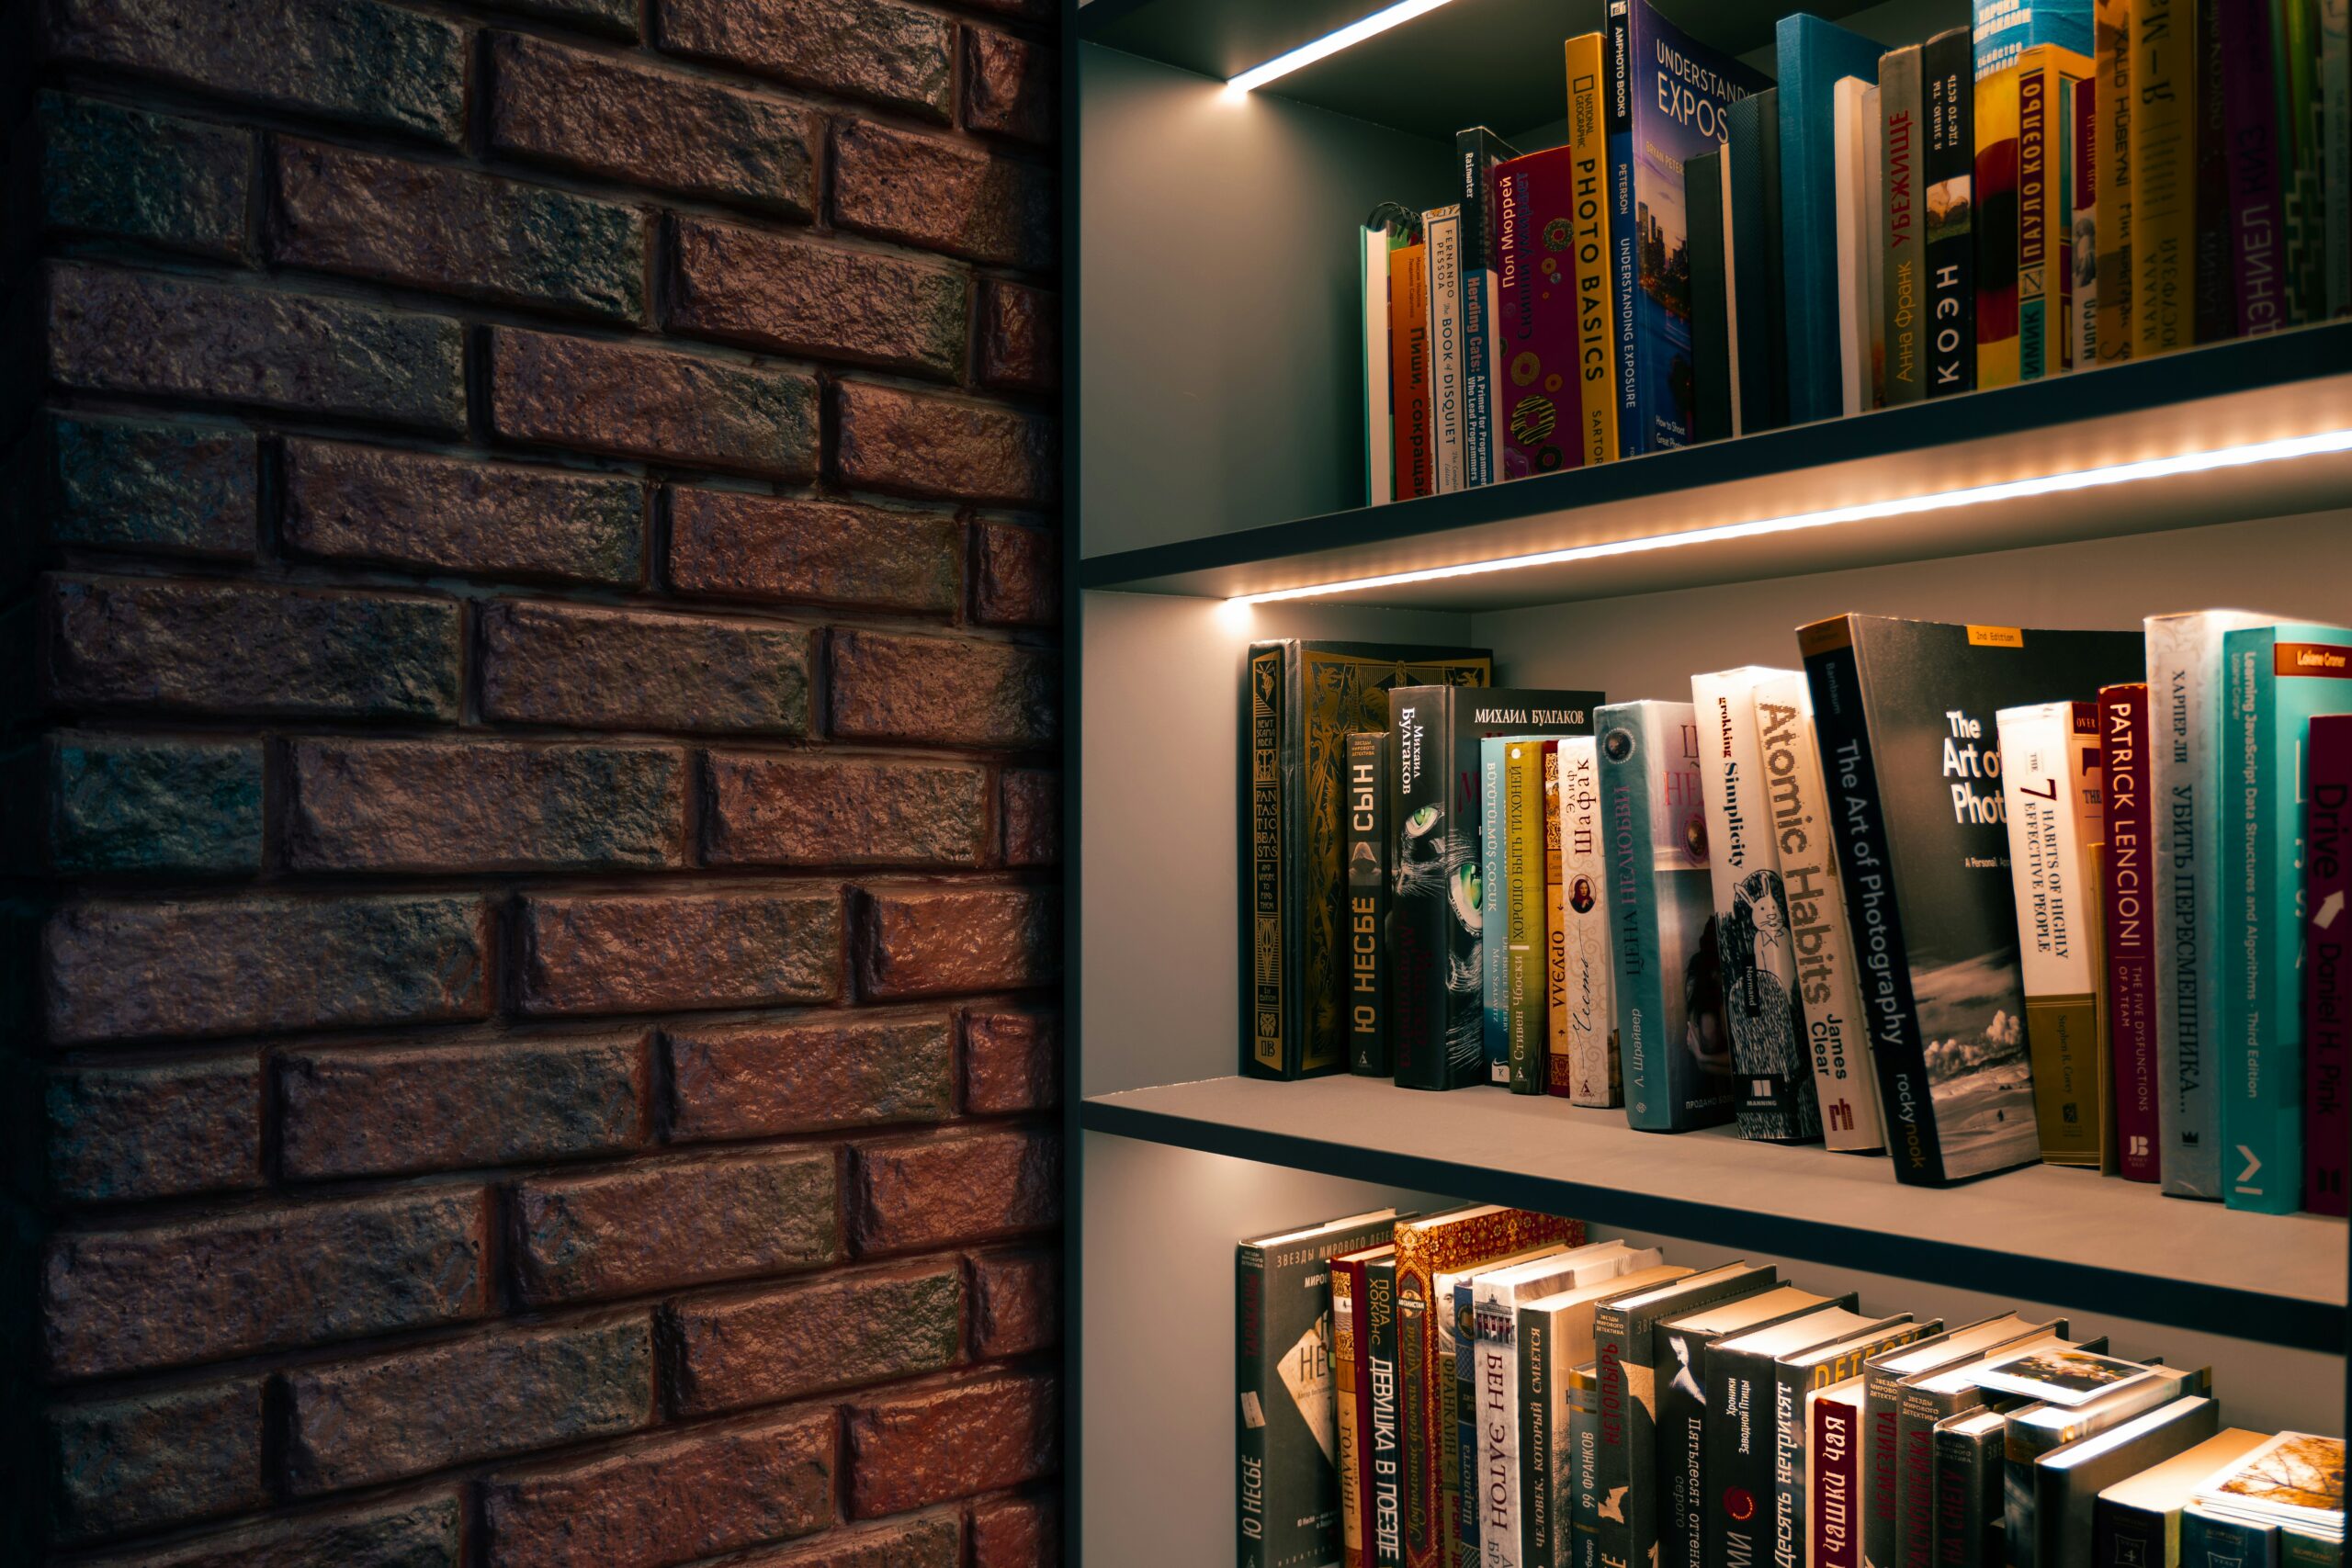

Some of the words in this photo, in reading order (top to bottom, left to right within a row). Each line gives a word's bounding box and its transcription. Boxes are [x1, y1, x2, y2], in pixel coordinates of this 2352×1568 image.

[1615, 26, 1625, 78] AMPHOTO
[1585, 94, 1596, 136] NATIONAL
[1617, 80, 1626, 118] BOOKS
[1948, 73, 1958, 107] есть
[1576, 96, 1587, 149] GEOGRAPHIC
[1948, 108, 1960, 147] где-то
[2022, 82, 2041, 175] КОЭЛЬО
[1465, 152, 1474, 198] Rainwater
[1645, 141, 1666, 163] BRYAN
[1890, 109, 1913, 249] УБЕЖИЩЕ
[1499, 176, 1516, 250] Мюррей
[1577, 158, 1600, 265] PHOTO
[1618, 164, 1629, 215] PETERSON
[2022, 182, 2041, 258] ПАУЛО
[1436, 242, 1446, 290] PESSOA
[1445, 230, 1454, 299] FERNANDO
[1502, 255, 1515, 288] Пол
[1620, 238, 1634, 343] UNDERSTANDING
[1466, 276, 1481, 333] Herding
[1518, 265, 1533, 340] Скиппи
[1894, 261, 1915, 330] Франк
[2143, 253, 2158, 343] МАЛАЛА
[2161, 236, 2179, 349] ЮСУФЗАЙ
[1442, 318, 1453, 362] BOOK
[1581, 276, 1604, 381] BASICS
[1936, 265, 1961, 385] КОЭН
[1410, 326, 1425, 390] Пиши,
[1468, 336, 1482, 373] Cats:
[1623, 344, 1636, 409] EXPOSURE
[1896, 333, 1914, 383] Анна
[1442, 374, 1456, 445] DISQUIET
[1467, 397, 1476, 414] Lead
[1477, 383, 1486, 413] Primer
[1468, 416, 1477, 481] Programmers
[1657, 432, 1670, 447] Great
[1975, 631, 1987, 641] 2nd
[1989, 632, 2015, 642] Edition
[1825, 661, 1841, 715] Barnbaum
[2172, 670, 2187, 739] ХАРПЕР
[2243, 651, 2257, 712] Learning
[1475, 708, 1528, 724] МИХАИЛ
[1532, 710, 1584, 727] БУЛГАКОВ
[1717, 696, 1733, 758] grokking
[1946, 710, 1982, 739] The
[2076, 717, 2096, 728] OVER
[1399, 707, 1416, 795] Булгаков
[1413, 725, 1423, 779] Михаил
[1837, 739, 1860, 789] The
[1942, 737, 1982, 778] Art
[2030, 752, 2038, 773] THE
[2109, 703, 2135, 810] PATRICK
[2174, 742, 2188, 764] ЛИ
[2244, 714, 2258, 784] JavaScript
[1256, 790, 1277, 802] FAN
[1353, 764, 1376, 832] СЫН
[1510, 765, 1523, 834] ТИХОНЕЙ
[1566, 770, 1577, 813] Элиф
[1759, 701, 1814, 855] Atomic
[2019, 778, 2057, 801] 7
[2245, 788, 2258, 819] Data
[1257, 804, 1278, 816] TAS
[1257, 818, 1278, 829] TIC
[1486, 761, 1498, 857] BÜYÜTÜLMÜŞ
[1575, 758, 1597, 854] Шафак
[1721, 761, 1746, 870] Simplicity
[1845, 796, 1870, 837] Art
[2173, 784, 2194, 869] УБИТЬ
[2312, 784, 2348, 879] Drive
[1257, 832, 1277, 843] BEA
[1257, 845, 1278, 858] STS
[1512, 837, 1523, 874] БЫТЬ
[1614, 785, 1636, 904] НЕЛЮБВИ
[1853, 841, 1880, 866] of
[1971, 857, 1996, 868] Personal
[2024, 801, 2044, 889] EFFECTIVE
[2041, 809, 2059, 869] HABITS
[2245, 822, 2257, 888] Structures
[1486, 861, 1497, 912] ÇOCUK
[2050, 872, 2064, 888] OF
[2115, 819, 2141, 946] LENCIONI
[2245, 890, 2257, 921] and
[1512, 879, 1524, 940] ХОРОШО
[1784, 867, 1833, 1007] Habits
[2033, 892, 2052, 953] PEOPLE
[2051, 890, 2069, 958] HIGHLY
[1351, 897, 1376, 993] НЕСБЁ
[1623, 910, 1644, 976] ЦЕНА
[1860, 875, 1907, 1045] Photography
[2245, 925, 2258, 1000] Algorithms
[1512, 955, 1523, 1007] Чбоски
[1746, 964, 1757, 1007] Normand
[2118, 965, 2127, 982] OF
[2132, 965, 2143, 989] THE
[2316, 942, 2343, 1024] Daniel
[1353, 1005, 1376, 1034] Ю
[2120, 997, 2130, 1027] TEAM
[2133, 992, 2143, 1016] FIVE
[2247, 1011, 2259, 1047] Third
[1513, 1010, 1524, 1060] Стивен
[1631, 1008, 1646, 1072] Шрайвер
[1811, 1021, 1829, 1077] Clear
[1826, 1014, 1847, 1080] James
[2057, 1014, 2067, 1053] Stephen
[2134, 1020, 2148, 1111] DYSFUNCTIONS
[2247, 1049, 2259, 1099] Edition
[2317, 1063, 2341, 1116] Pink
[1895, 1073, 1927, 1168] rockynook
[1277, 1248, 1315, 1268] ЗВЕЗДЫ
[1318, 1237, 1365, 1260] МИРОВОГО
[1369, 1278, 1382, 1346] ХОКИНС
[1378, 1279, 1390, 1326] ПОЛА
[1596, 1319, 1624, 1329] МИРОВОГО
[1600, 1314, 1619, 1322] ЗВЕЗДЫ
[1596, 1325, 1624, 1336] ДЕТЕКТИВА
[1487, 1352, 1505, 1412] БЕН
[1532, 1327, 1542, 1393] СМЕЕТСЯ
[1369, 1356, 1396, 1451] ДЕВУШКА
[1442, 1359, 1456, 1457] ФРАНКЛИН
[1602, 1342, 1623, 1446] НЕТОПЫРЬ
[1725, 1377, 1736, 1416] Хроники
[1738, 1380, 1750, 1409] Птицы
[1903, 1402, 1939, 1415] МИРОВОГО
[1903, 1409, 1940, 1422] ДЕТЕКТИВА
[1907, 1395, 1934, 1406] ЗВЕЗДЫ
[1531, 1402, 1544, 1472] КОТОРЫЙ
[1738, 1410, 1750, 1455] Заводной
[1777, 1381, 1798, 1485] негритят
[1822, 1416, 1847, 1462] чая
[1242, 1454, 1262, 1514] НЕСБЁ
[1340, 1425, 1355, 1515] ГОЛДИНГ
[1375, 1460, 1396, 1475] В
[1463, 1443, 1476, 1525] Шарлотта
[1489, 1423, 1508, 1529] ЭЛТОН
[1581, 1431, 1595, 1490] ФРАНКОВ
[1689, 1417, 1702, 1506] Пятьдесят
[1876, 1412, 1897, 1521] НЕМЕЗИДА
[1376, 1481, 1399, 1561] ПОЕЗДЕ
[1582, 1494, 1595, 1510] 99
[1673, 1475, 1685, 1529] серого
[1822, 1470, 1847, 1553] чашки
[1939, 1469, 1968, 1531] СНЕГУ
[1242, 1517, 1262, 1540] Ю
[1774, 1492, 1797, 1568] Десять
